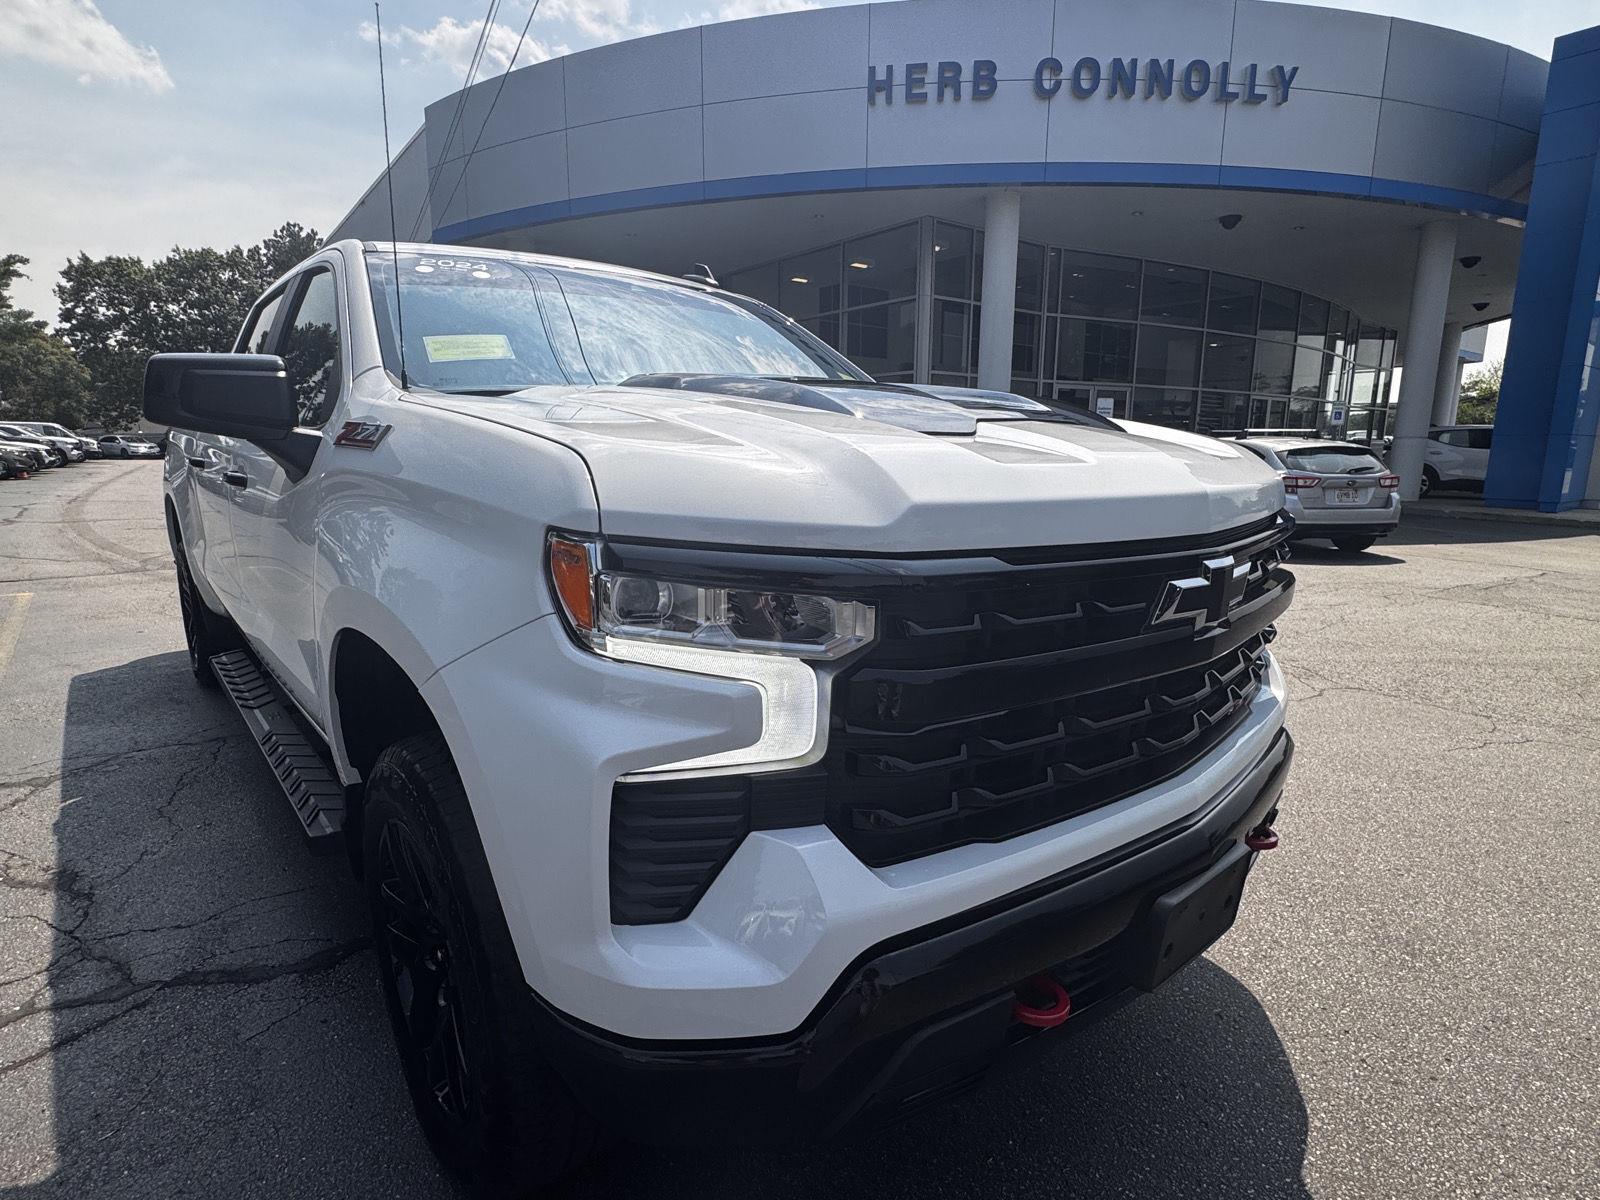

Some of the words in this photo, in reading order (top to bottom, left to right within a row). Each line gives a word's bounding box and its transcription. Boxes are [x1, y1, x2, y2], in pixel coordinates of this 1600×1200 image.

[868, 60, 998, 106] HERB
[1034, 57, 1299, 105] CONNOLLY
[420, 258, 488, 271] 2024
